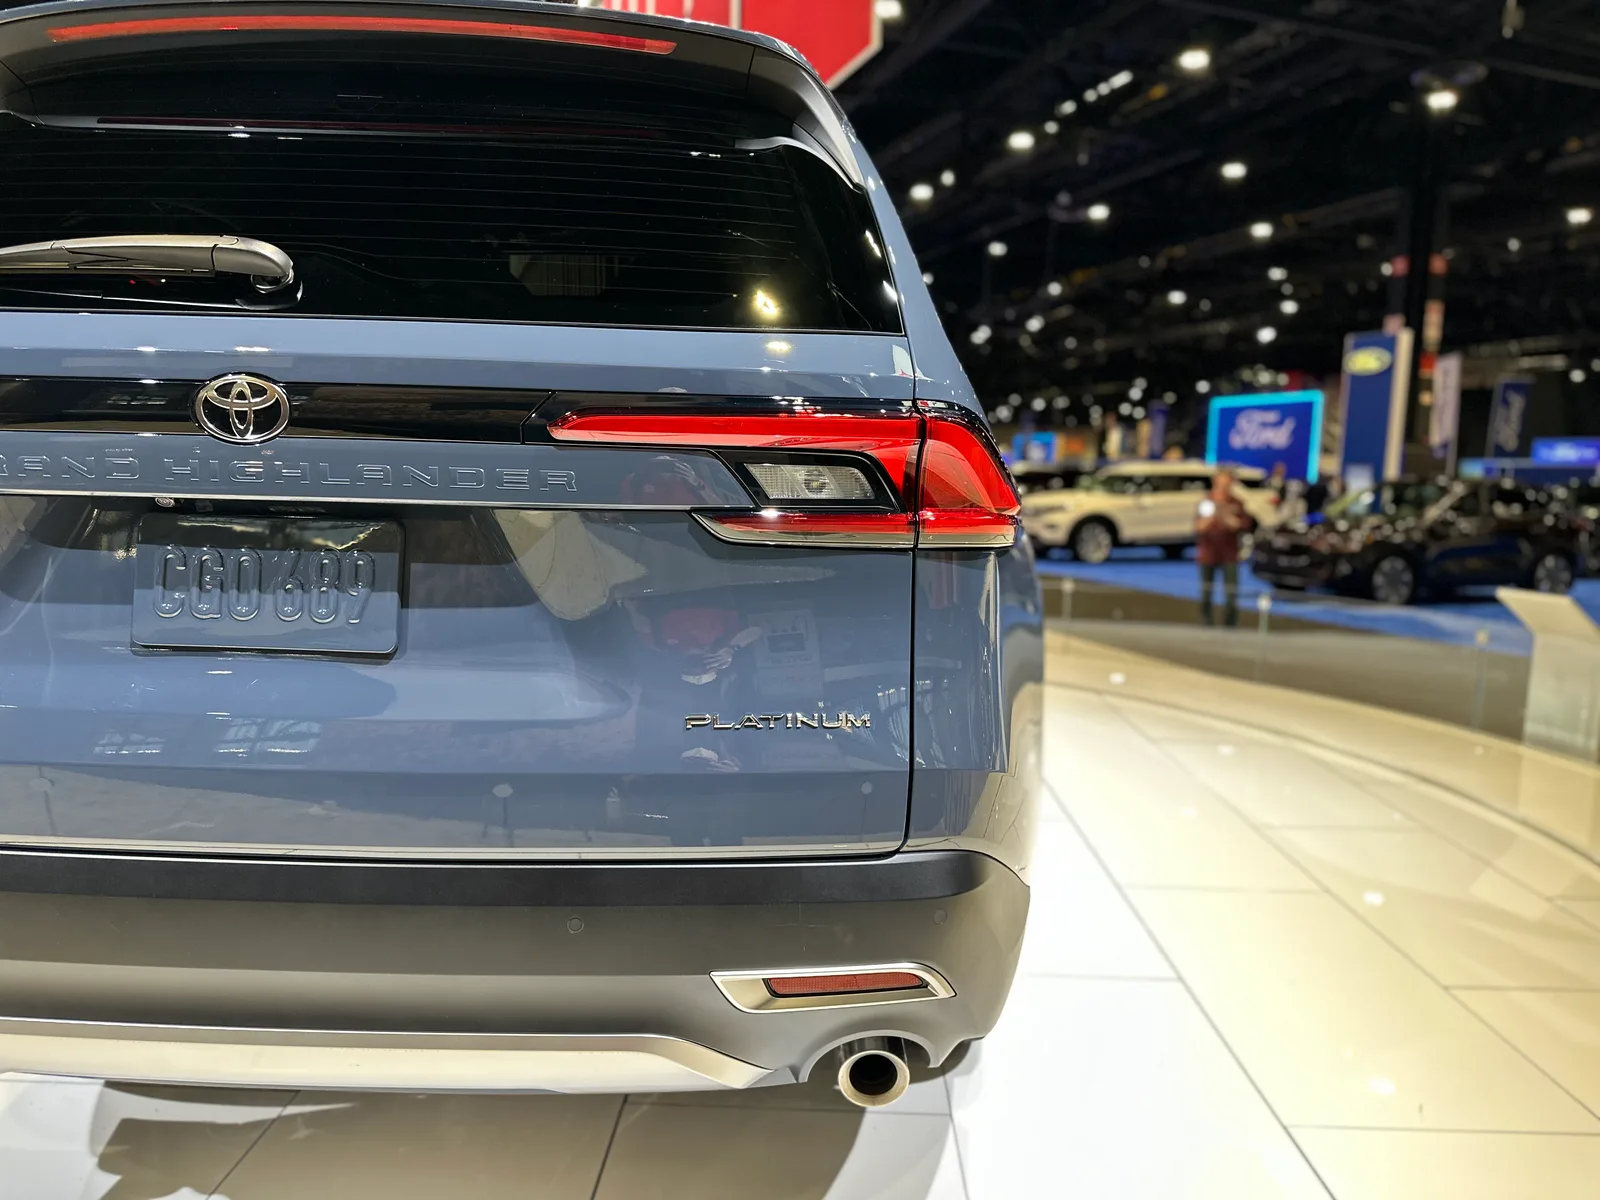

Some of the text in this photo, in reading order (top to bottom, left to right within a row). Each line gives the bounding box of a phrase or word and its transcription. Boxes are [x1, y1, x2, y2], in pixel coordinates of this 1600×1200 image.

[0, 454, 578, 492] AND HIGHLANDER
[684, 711, 872, 730] PLATINUM
